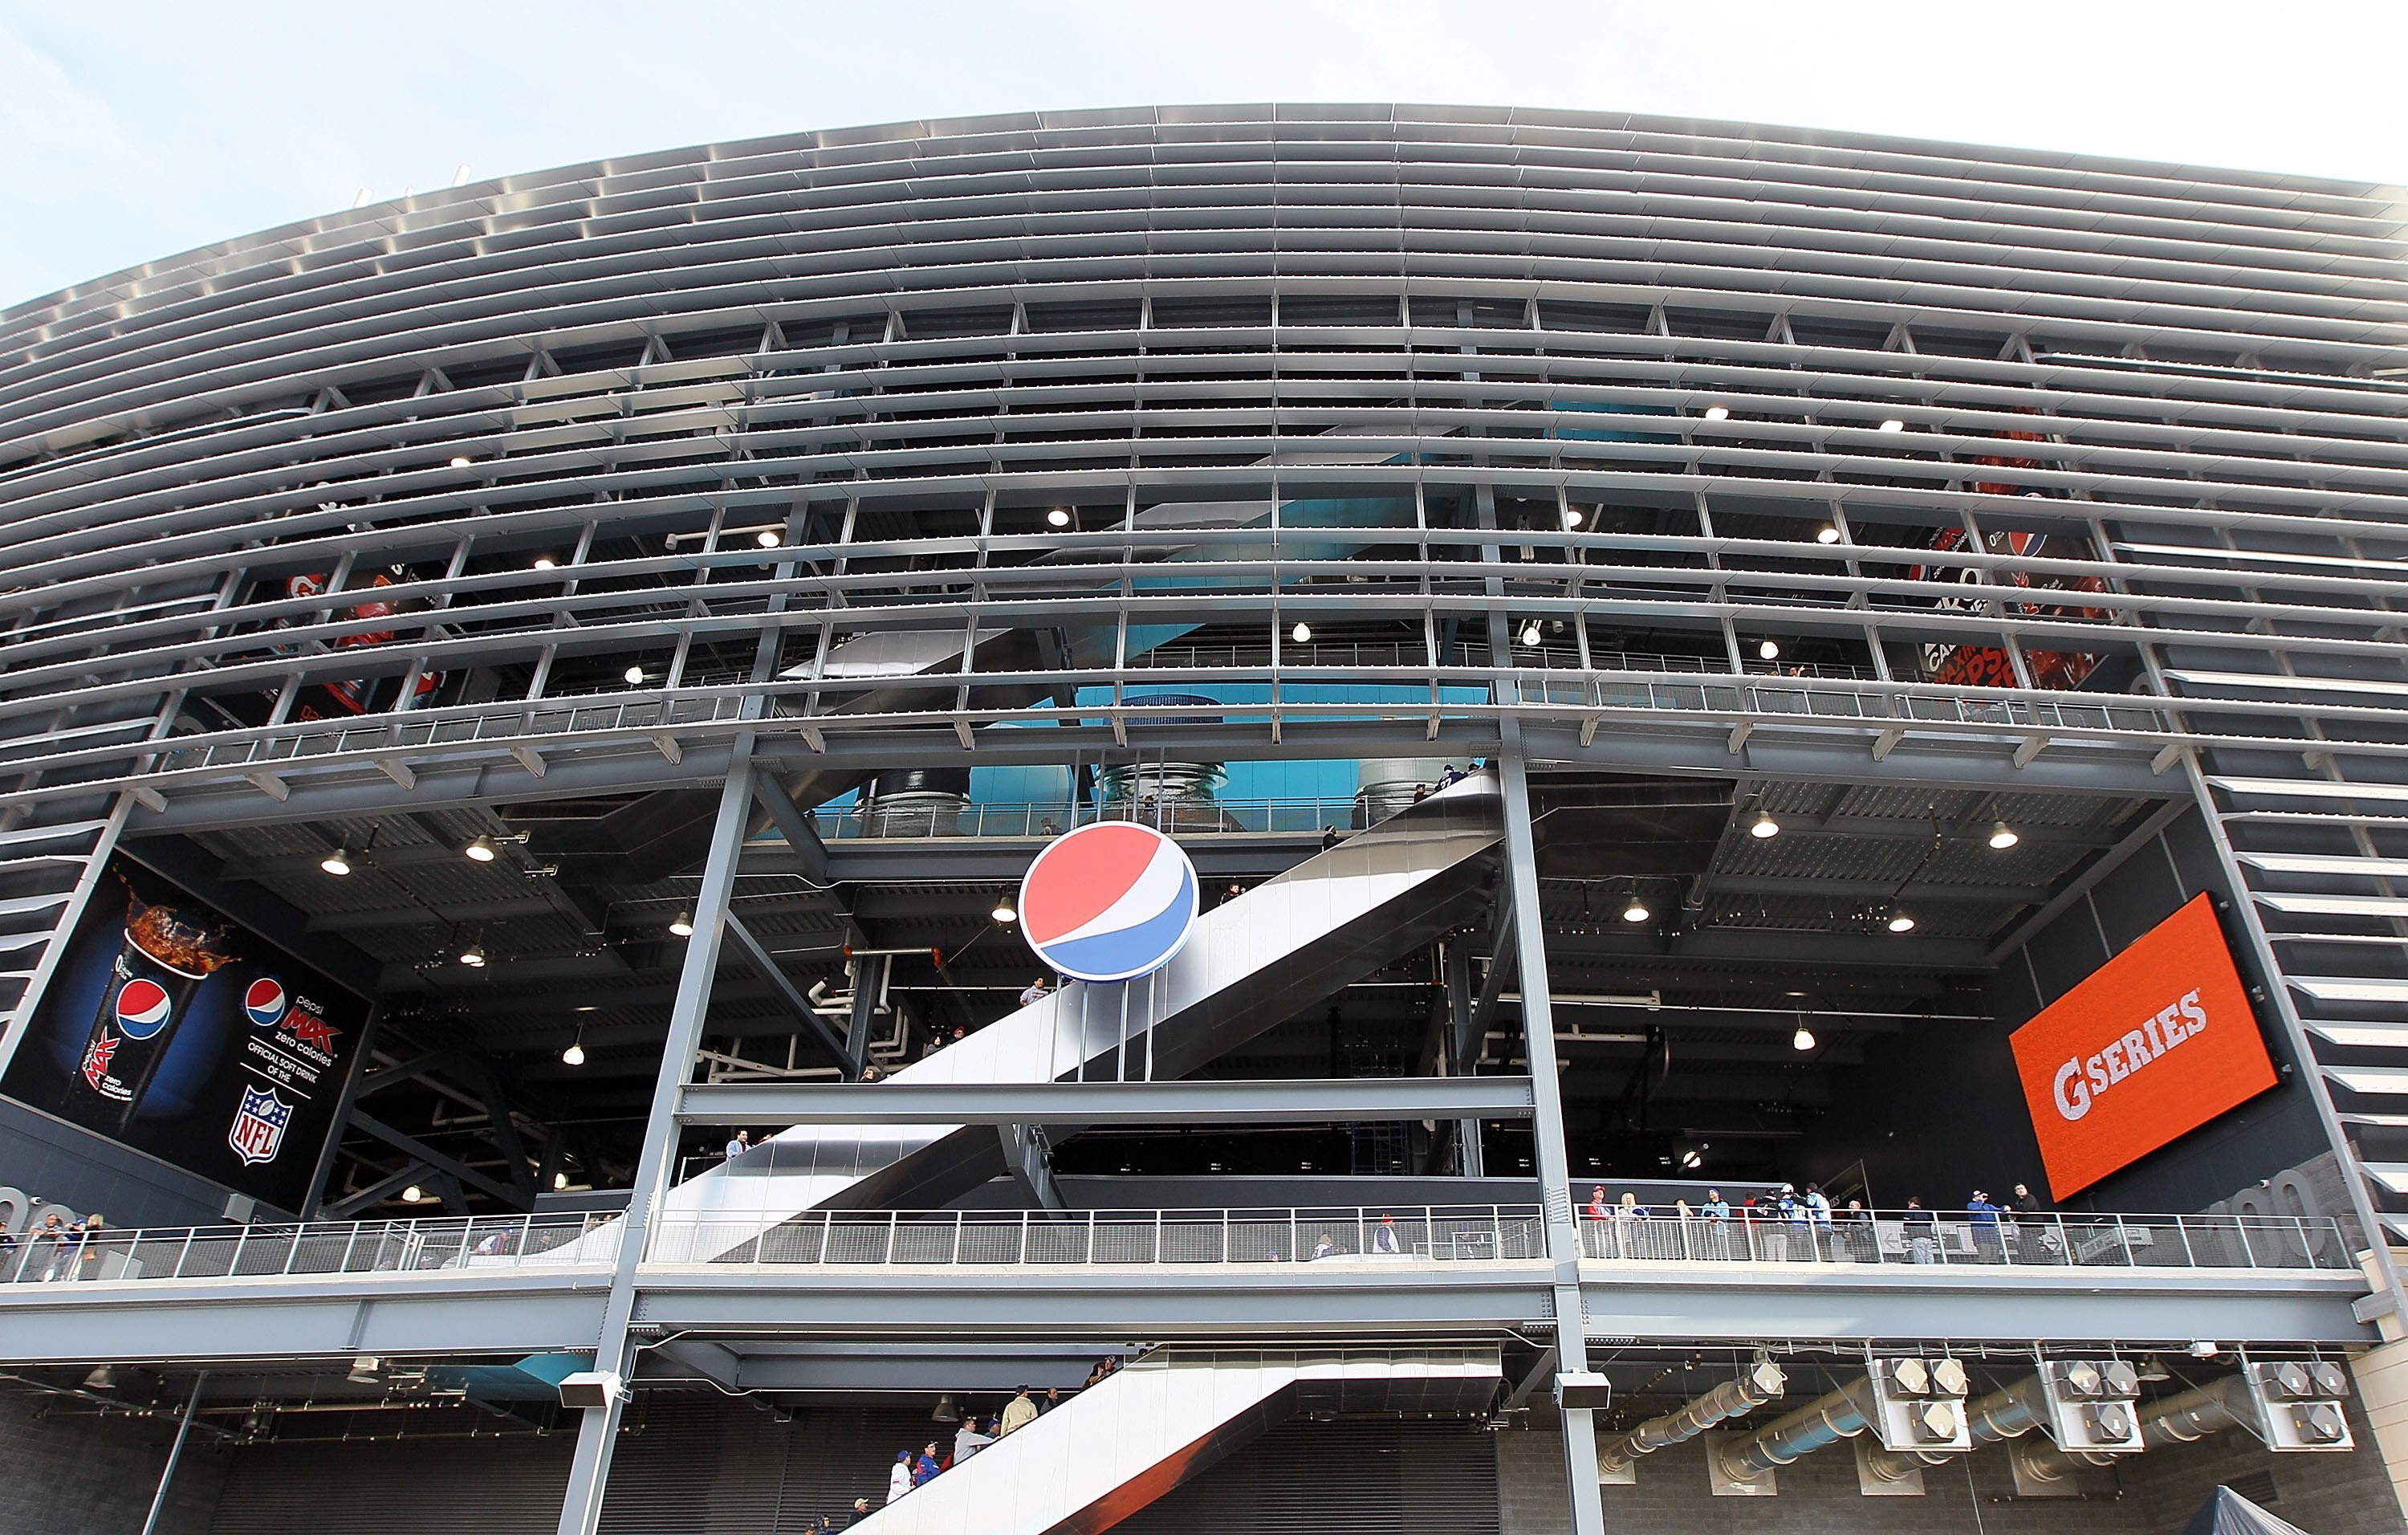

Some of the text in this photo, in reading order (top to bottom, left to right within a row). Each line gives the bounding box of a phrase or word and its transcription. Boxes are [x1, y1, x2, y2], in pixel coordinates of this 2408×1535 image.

[295, 996, 324, 1015] pepsi
[275, 1031, 332, 1067] zero calories
[279, 1006, 343, 1055] MAX
[2086, 989, 2207, 1097] SERIES
[85, 1024, 121, 1091] MAX
[248, 1042, 318, 1084] OFFICIAL SOFT DRINK
[267, 1065, 292, 1083] OF THE
[102, 1082, 132, 1096] calories
[104, 1075, 122, 1086] zero
[234, 1114, 275, 1155] NFL
